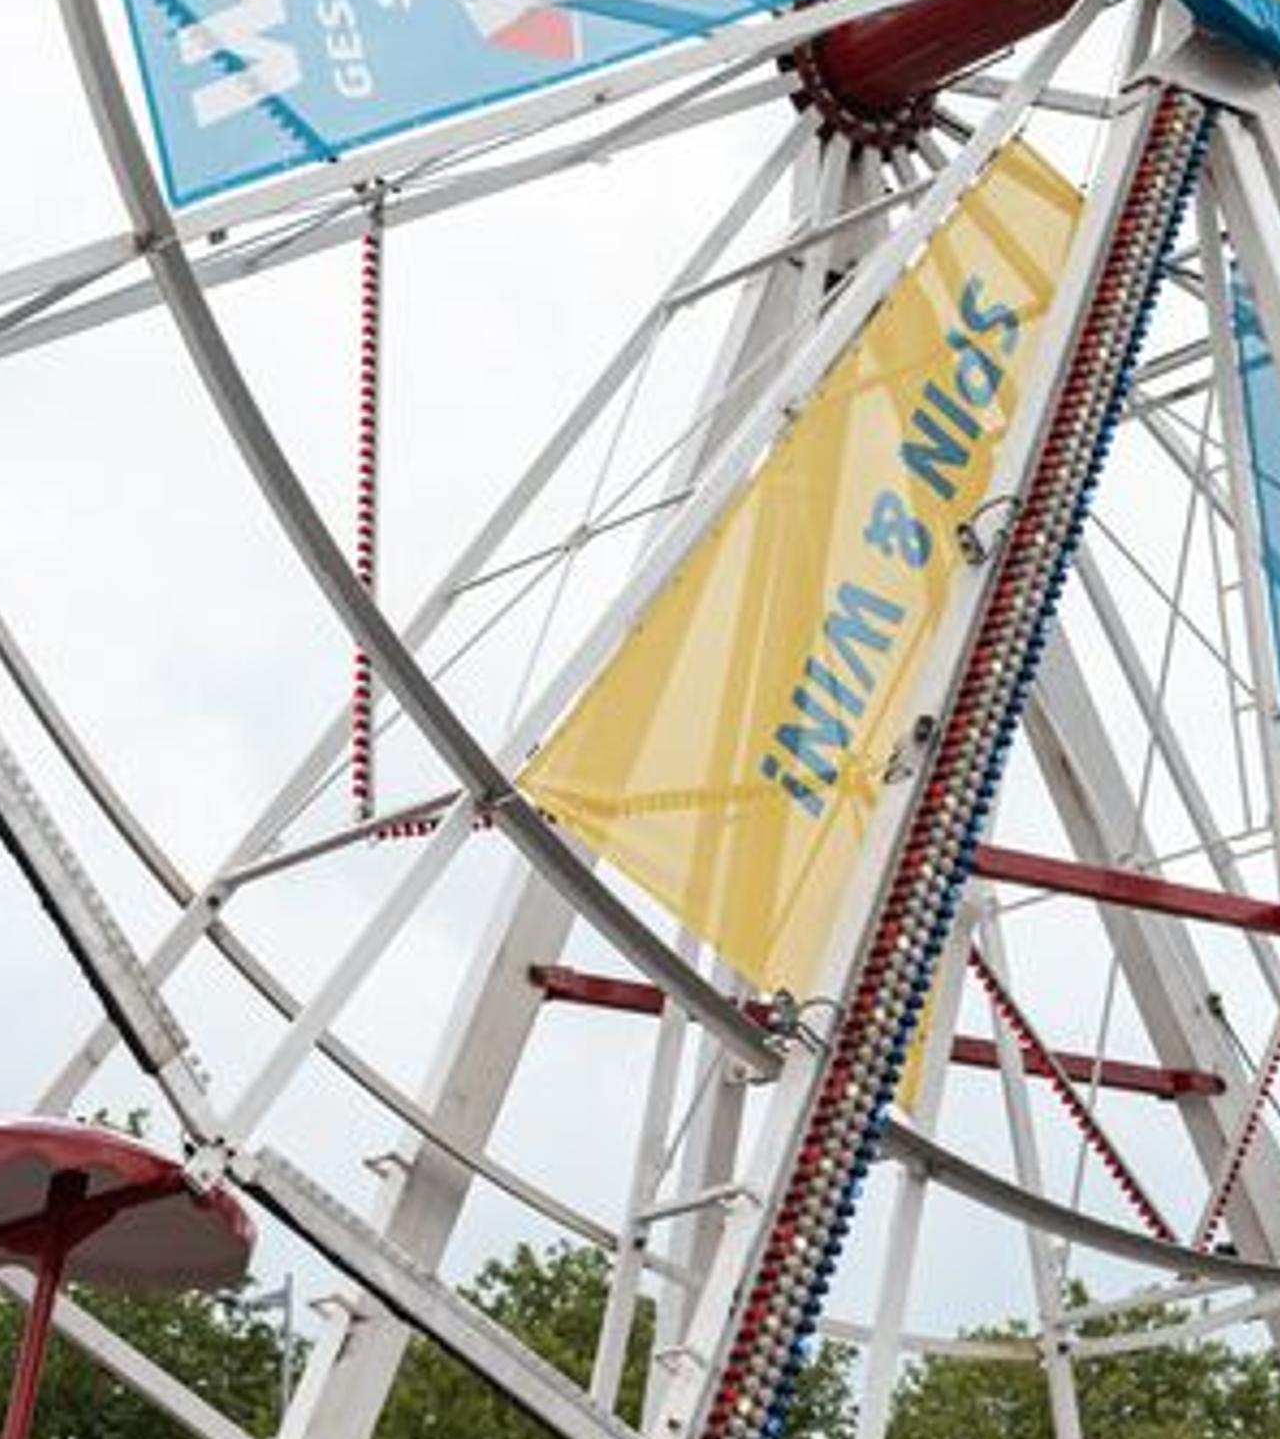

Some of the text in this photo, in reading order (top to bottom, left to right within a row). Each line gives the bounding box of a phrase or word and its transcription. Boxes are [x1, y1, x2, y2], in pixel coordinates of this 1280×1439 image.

[761, 275, 1021, 818] SPIN & WIN!
